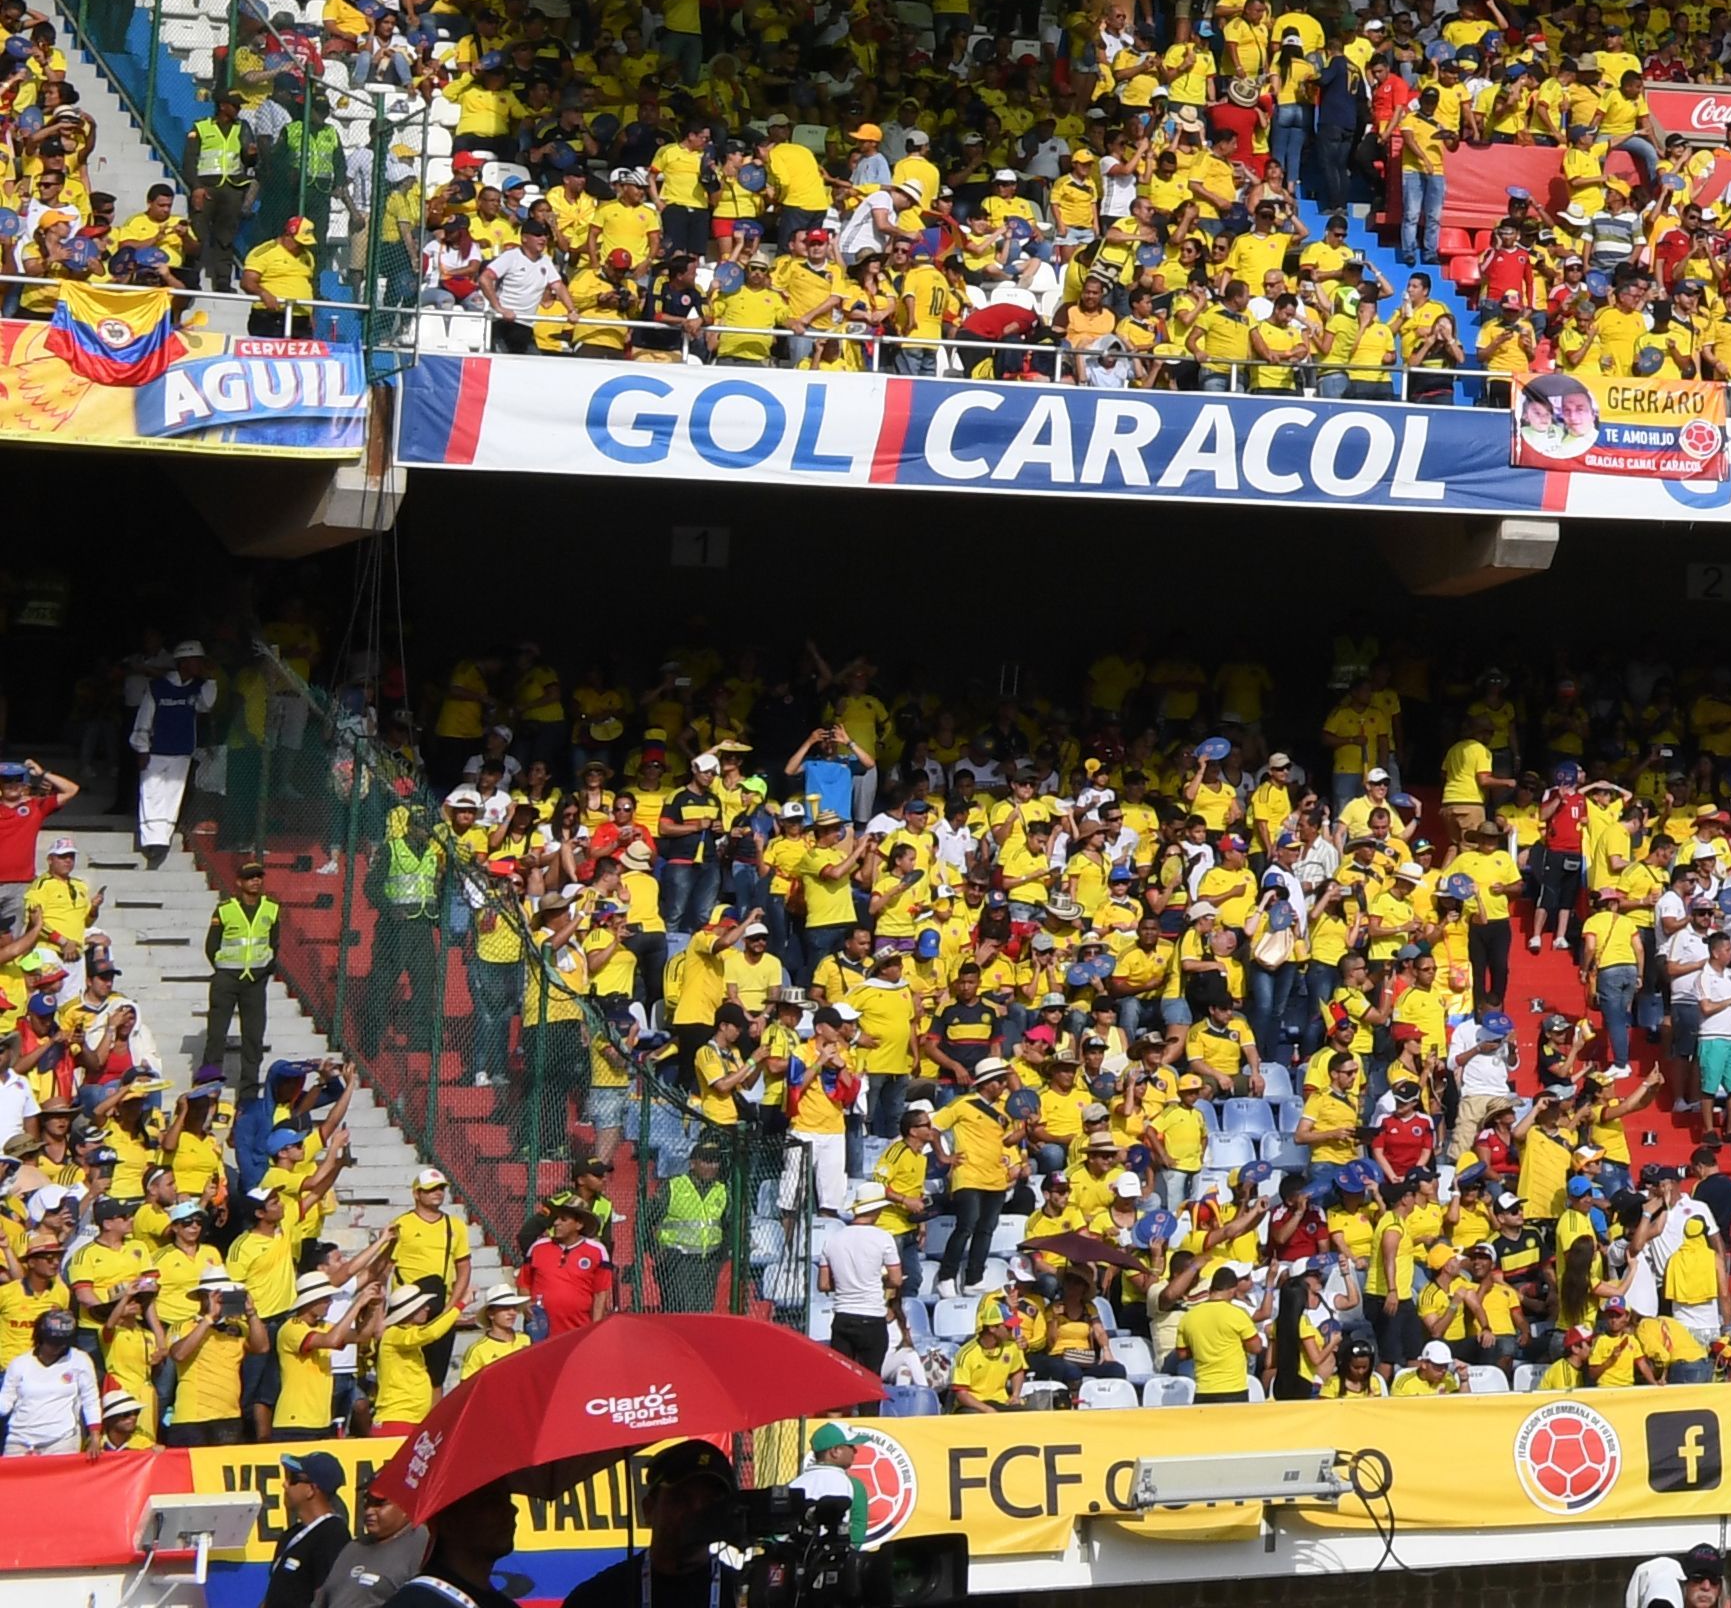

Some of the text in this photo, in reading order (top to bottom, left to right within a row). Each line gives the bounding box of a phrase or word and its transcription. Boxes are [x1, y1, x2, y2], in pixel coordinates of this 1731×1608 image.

[240, 342, 322, 356] CERVEZA
[585, 374, 853, 473] GOL
[924, 389, 1445, 501] CARACOL
[1604, 428, 1674, 446] TE AMO HIJO
[1585, 454, 1625, 469] GRACIAS
[1702, 566, 1723, 598] 2
[585, 1391, 664, 1416] Claro
[612, 1403, 679, 1425] sports
[630, 1415, 679, 1429] Colombia
[886, 1442, 912, 1484] DE FUTBOL
